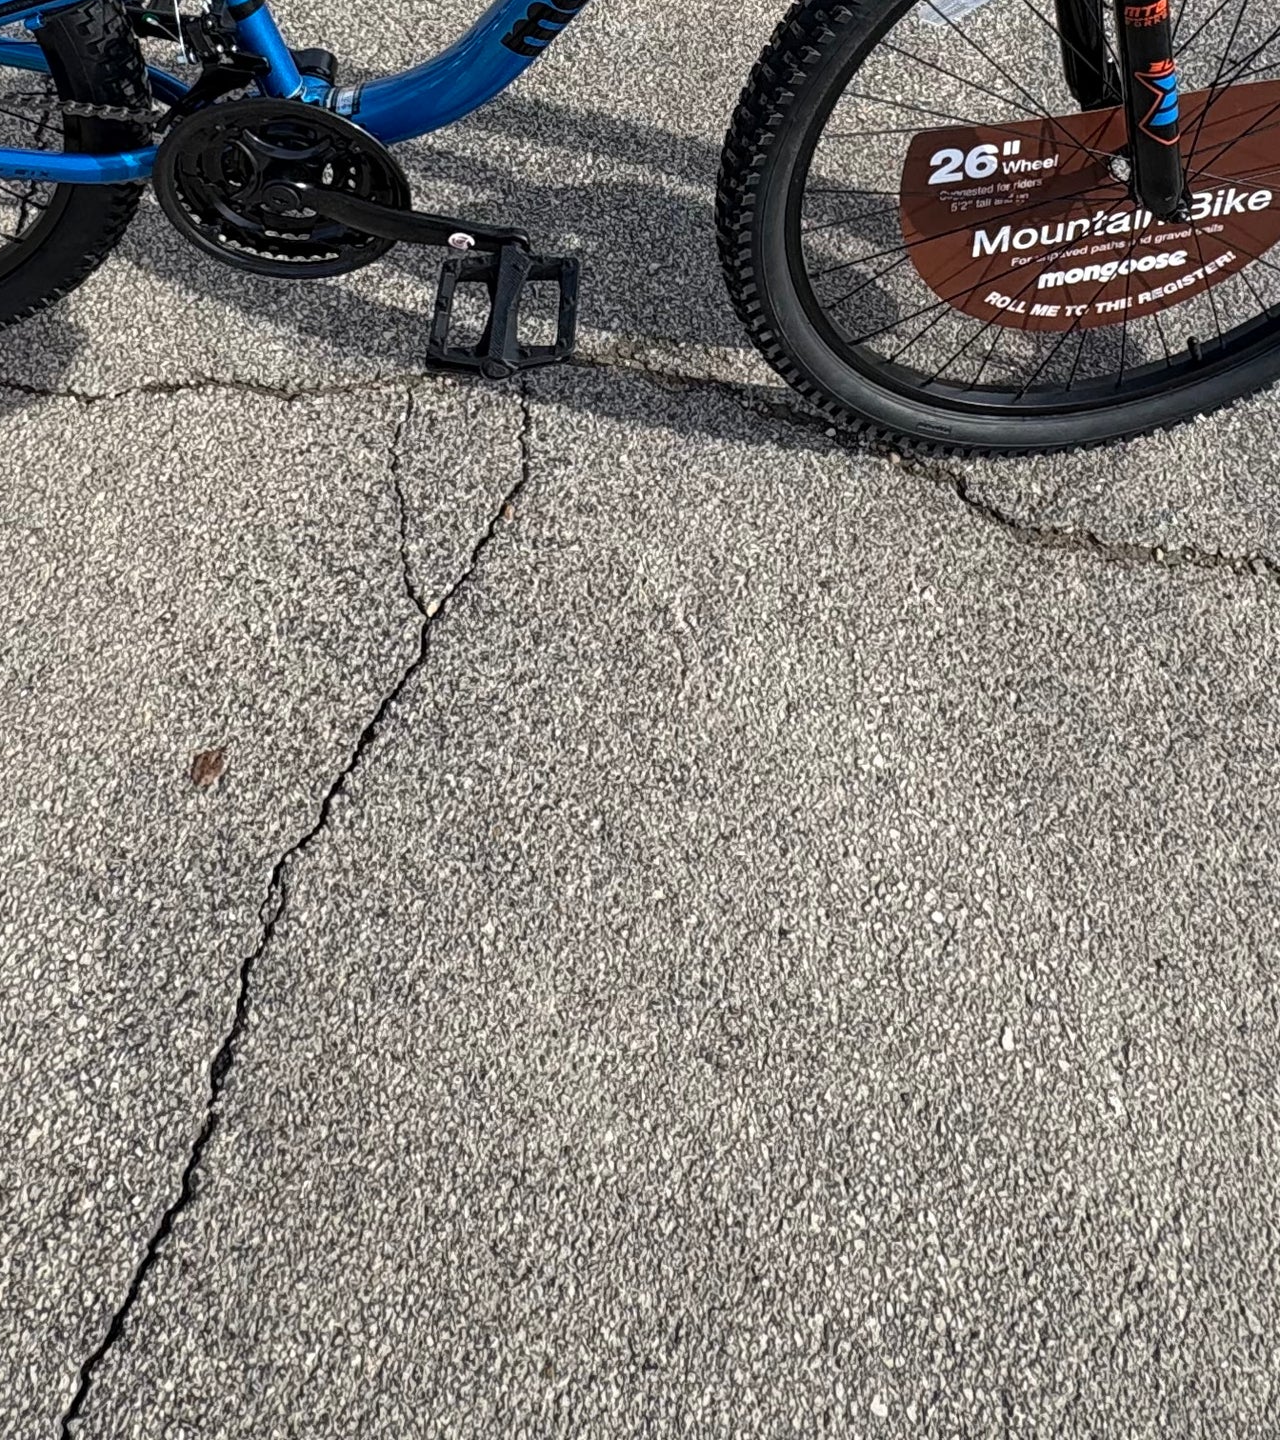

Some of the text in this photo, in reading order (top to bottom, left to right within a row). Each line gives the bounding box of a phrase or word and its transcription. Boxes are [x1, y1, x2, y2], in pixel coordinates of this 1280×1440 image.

[928, 140, 1059, 185] 26" Wheel
[976, 198, 992, 208] tall
[996, 182, 1010, 193] for
[1012, 178, 1042, 191] riders
[1182, 188, 1272, 222] Bike
[1011, 255, 1032, 267] For
[1090, 239, 1125, 255] paths
[1154, 228, 1192, 245] gravel
[984, 250, 1238, 317] ROLL ME TO THE REGISTER!
[1037, 249, 1188, 289] mongoose
